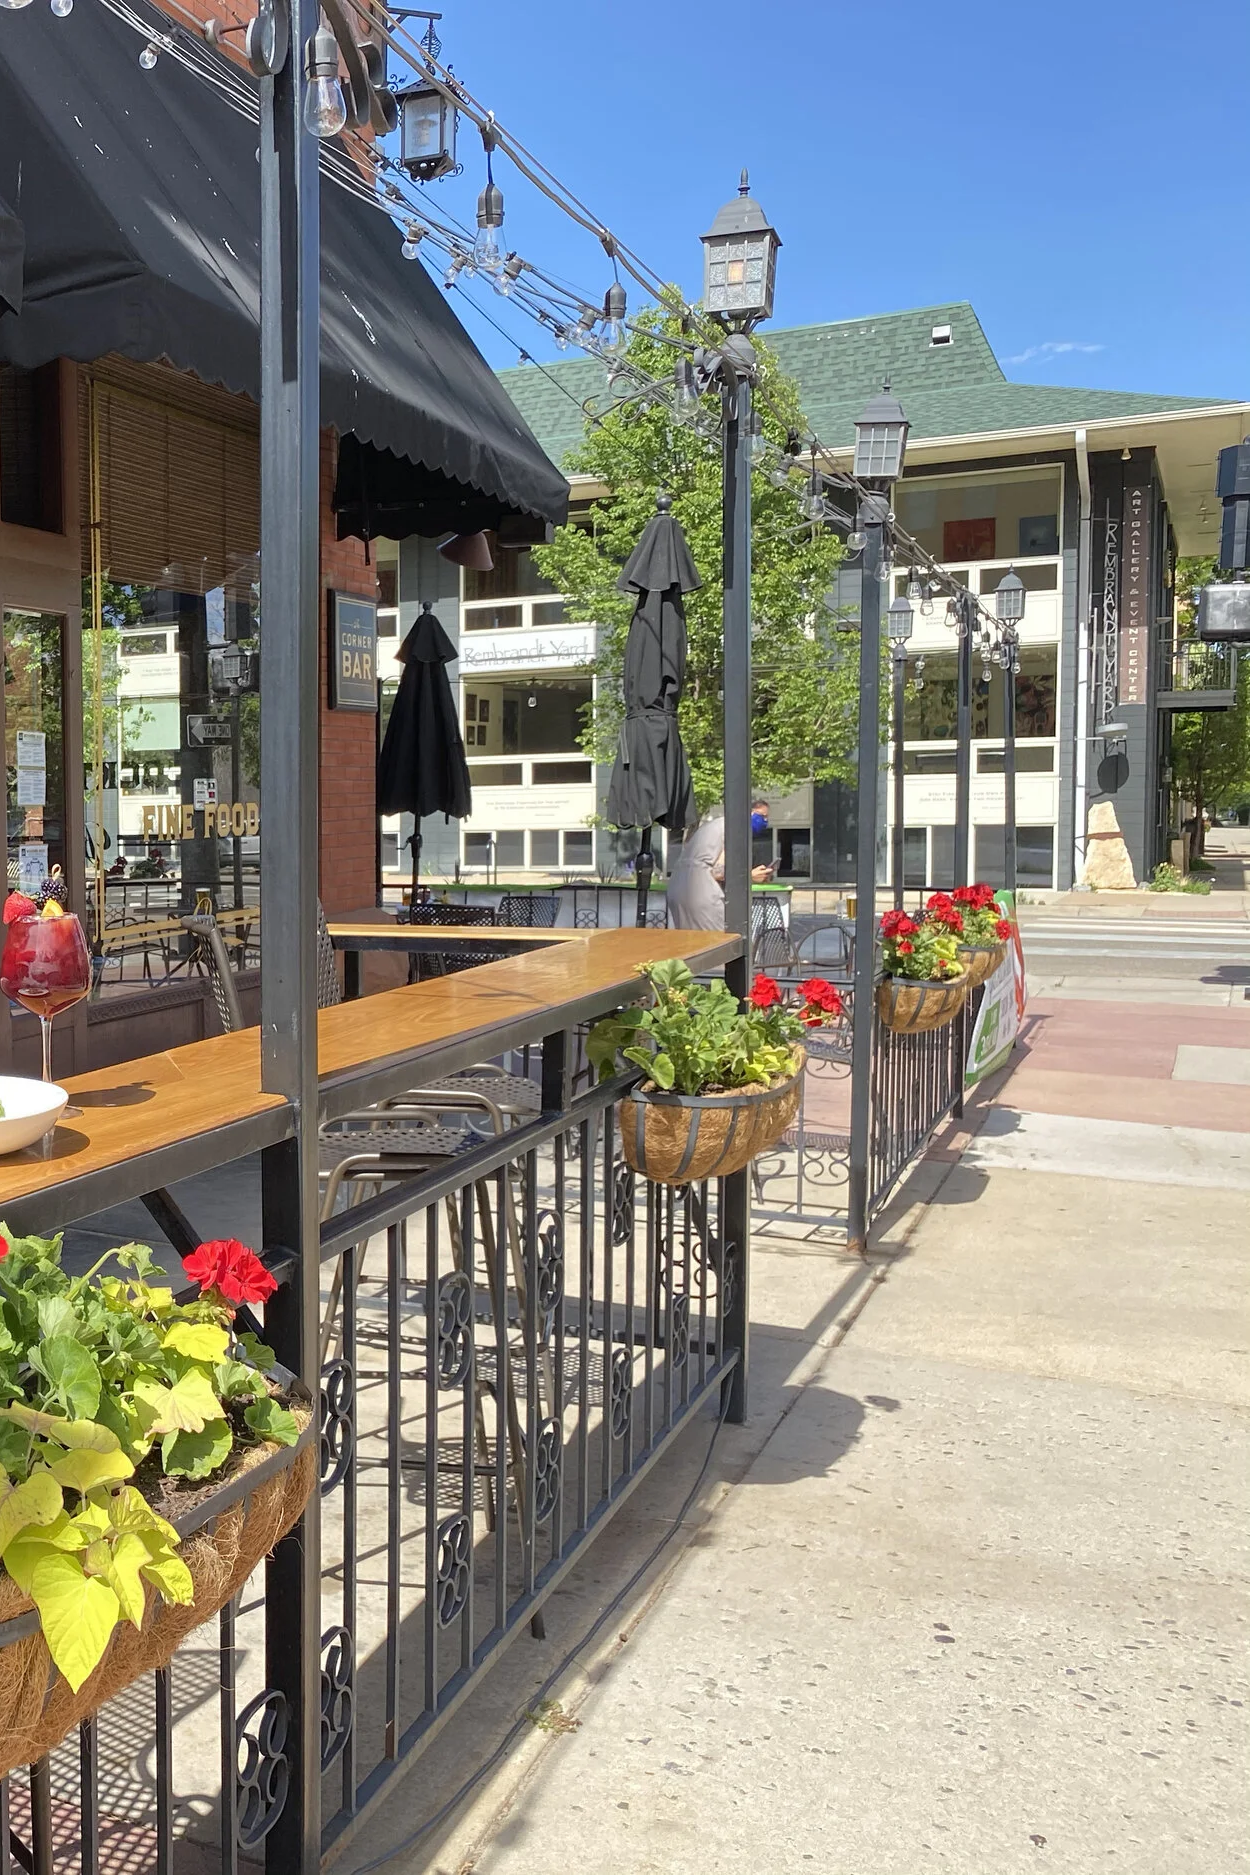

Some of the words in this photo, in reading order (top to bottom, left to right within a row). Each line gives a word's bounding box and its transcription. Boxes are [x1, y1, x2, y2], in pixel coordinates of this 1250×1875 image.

[1132, 489, 1142, 515] ART
[1130, 521, 1141, 583] GALLERY
[1129, 601, 1139, 644] EVENT
[341, 632, 372, 649] CORNER
[464, 638, 546, 664] Rembrandt
[550, 636, 589, 660] Yard
[342, 650, 372, 680] BAR
[1128, 649, 1139, 701] CENTER
[142, 804, 195, 842] FINE
[204, 802, 260, 838] FOOD
